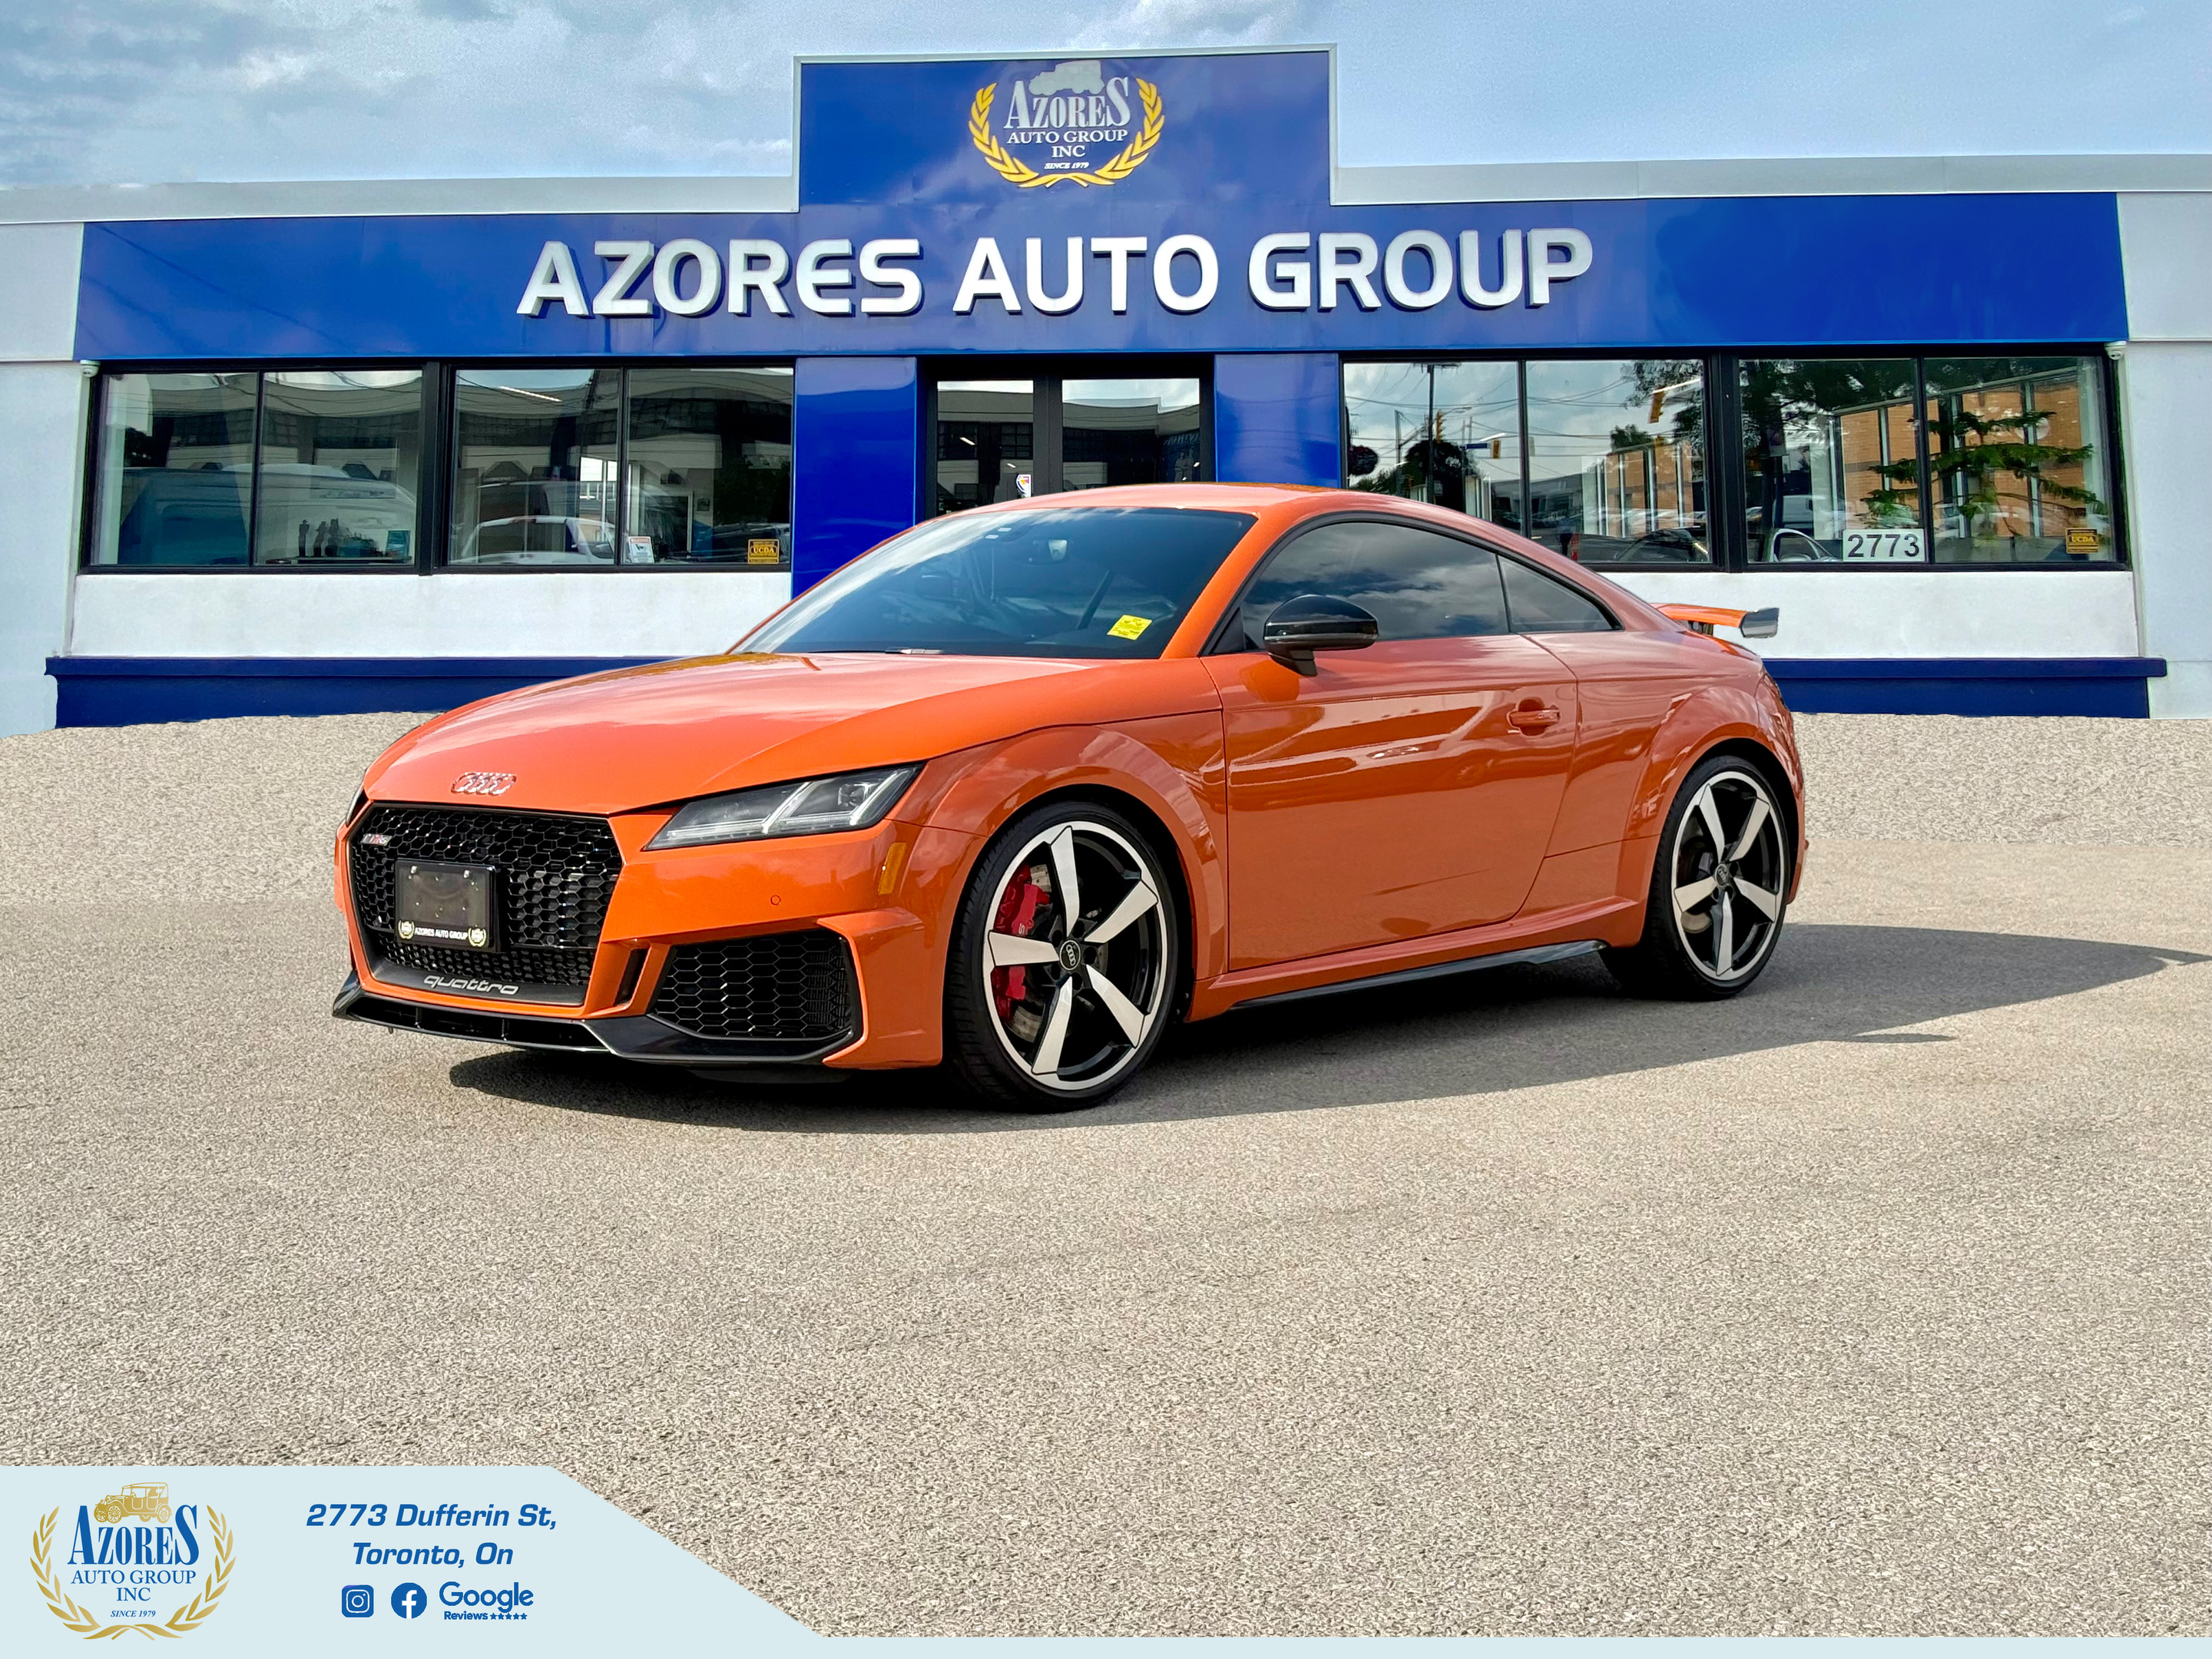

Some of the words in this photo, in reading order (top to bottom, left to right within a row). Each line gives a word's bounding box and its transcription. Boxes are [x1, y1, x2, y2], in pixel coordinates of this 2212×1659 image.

[1003, 77, 1131, 129] AZORES
[1007, 131, 1060, 144] AUTO
[1063, 129, 1128, 143] GROUP
[1051, 145, 1086, 158] INC
[516, 237, 923, 317] AZORES
[952, 233, 1220, 316] AUTO
[1248, 227, 1594, 311] GROUP
[1847, 533, 1919, 558] 2773
[415, 926, 435, 937] AZORES
[435, 929, 449, 939] AUTO
[449, 930, 469, 941] GROUP
[423, 975, 519, 995] quattro
